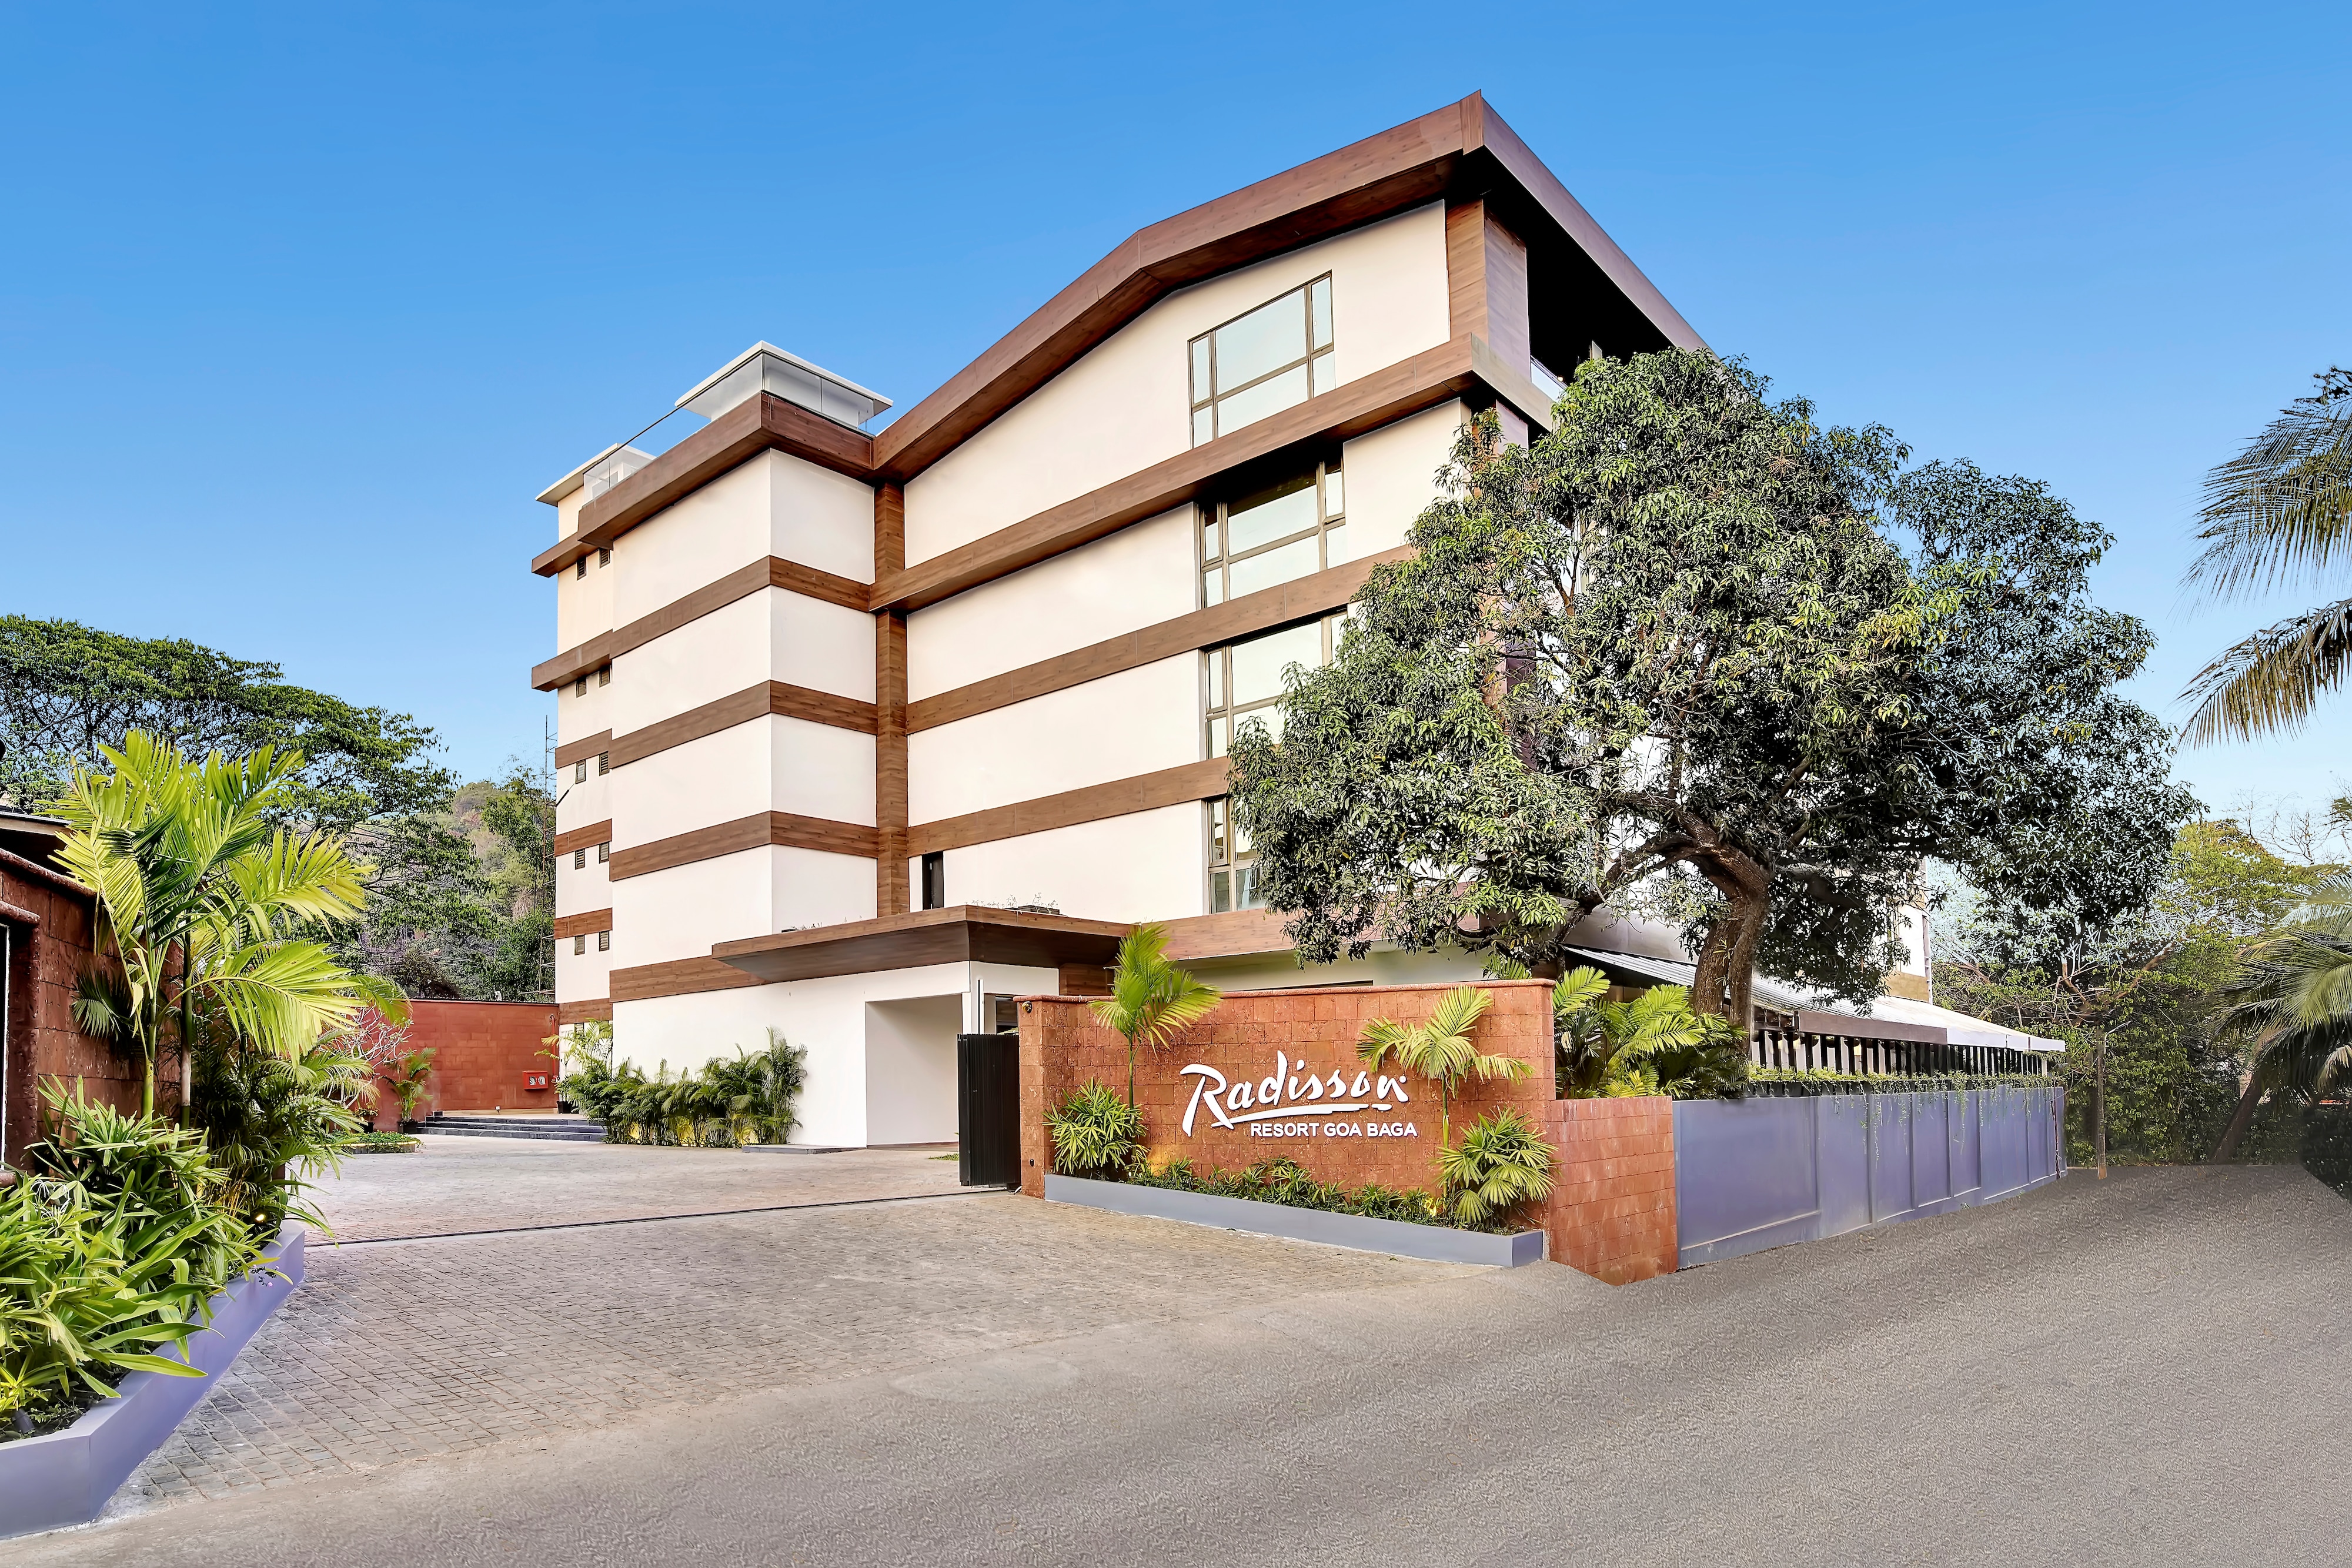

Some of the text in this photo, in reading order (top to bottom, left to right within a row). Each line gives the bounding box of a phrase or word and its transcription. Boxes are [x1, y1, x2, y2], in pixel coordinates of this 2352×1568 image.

[1180, 1050, 1409, 1137] Radisson
[1250, 1122, 1418, 1137] RESORT GOA BAGA
